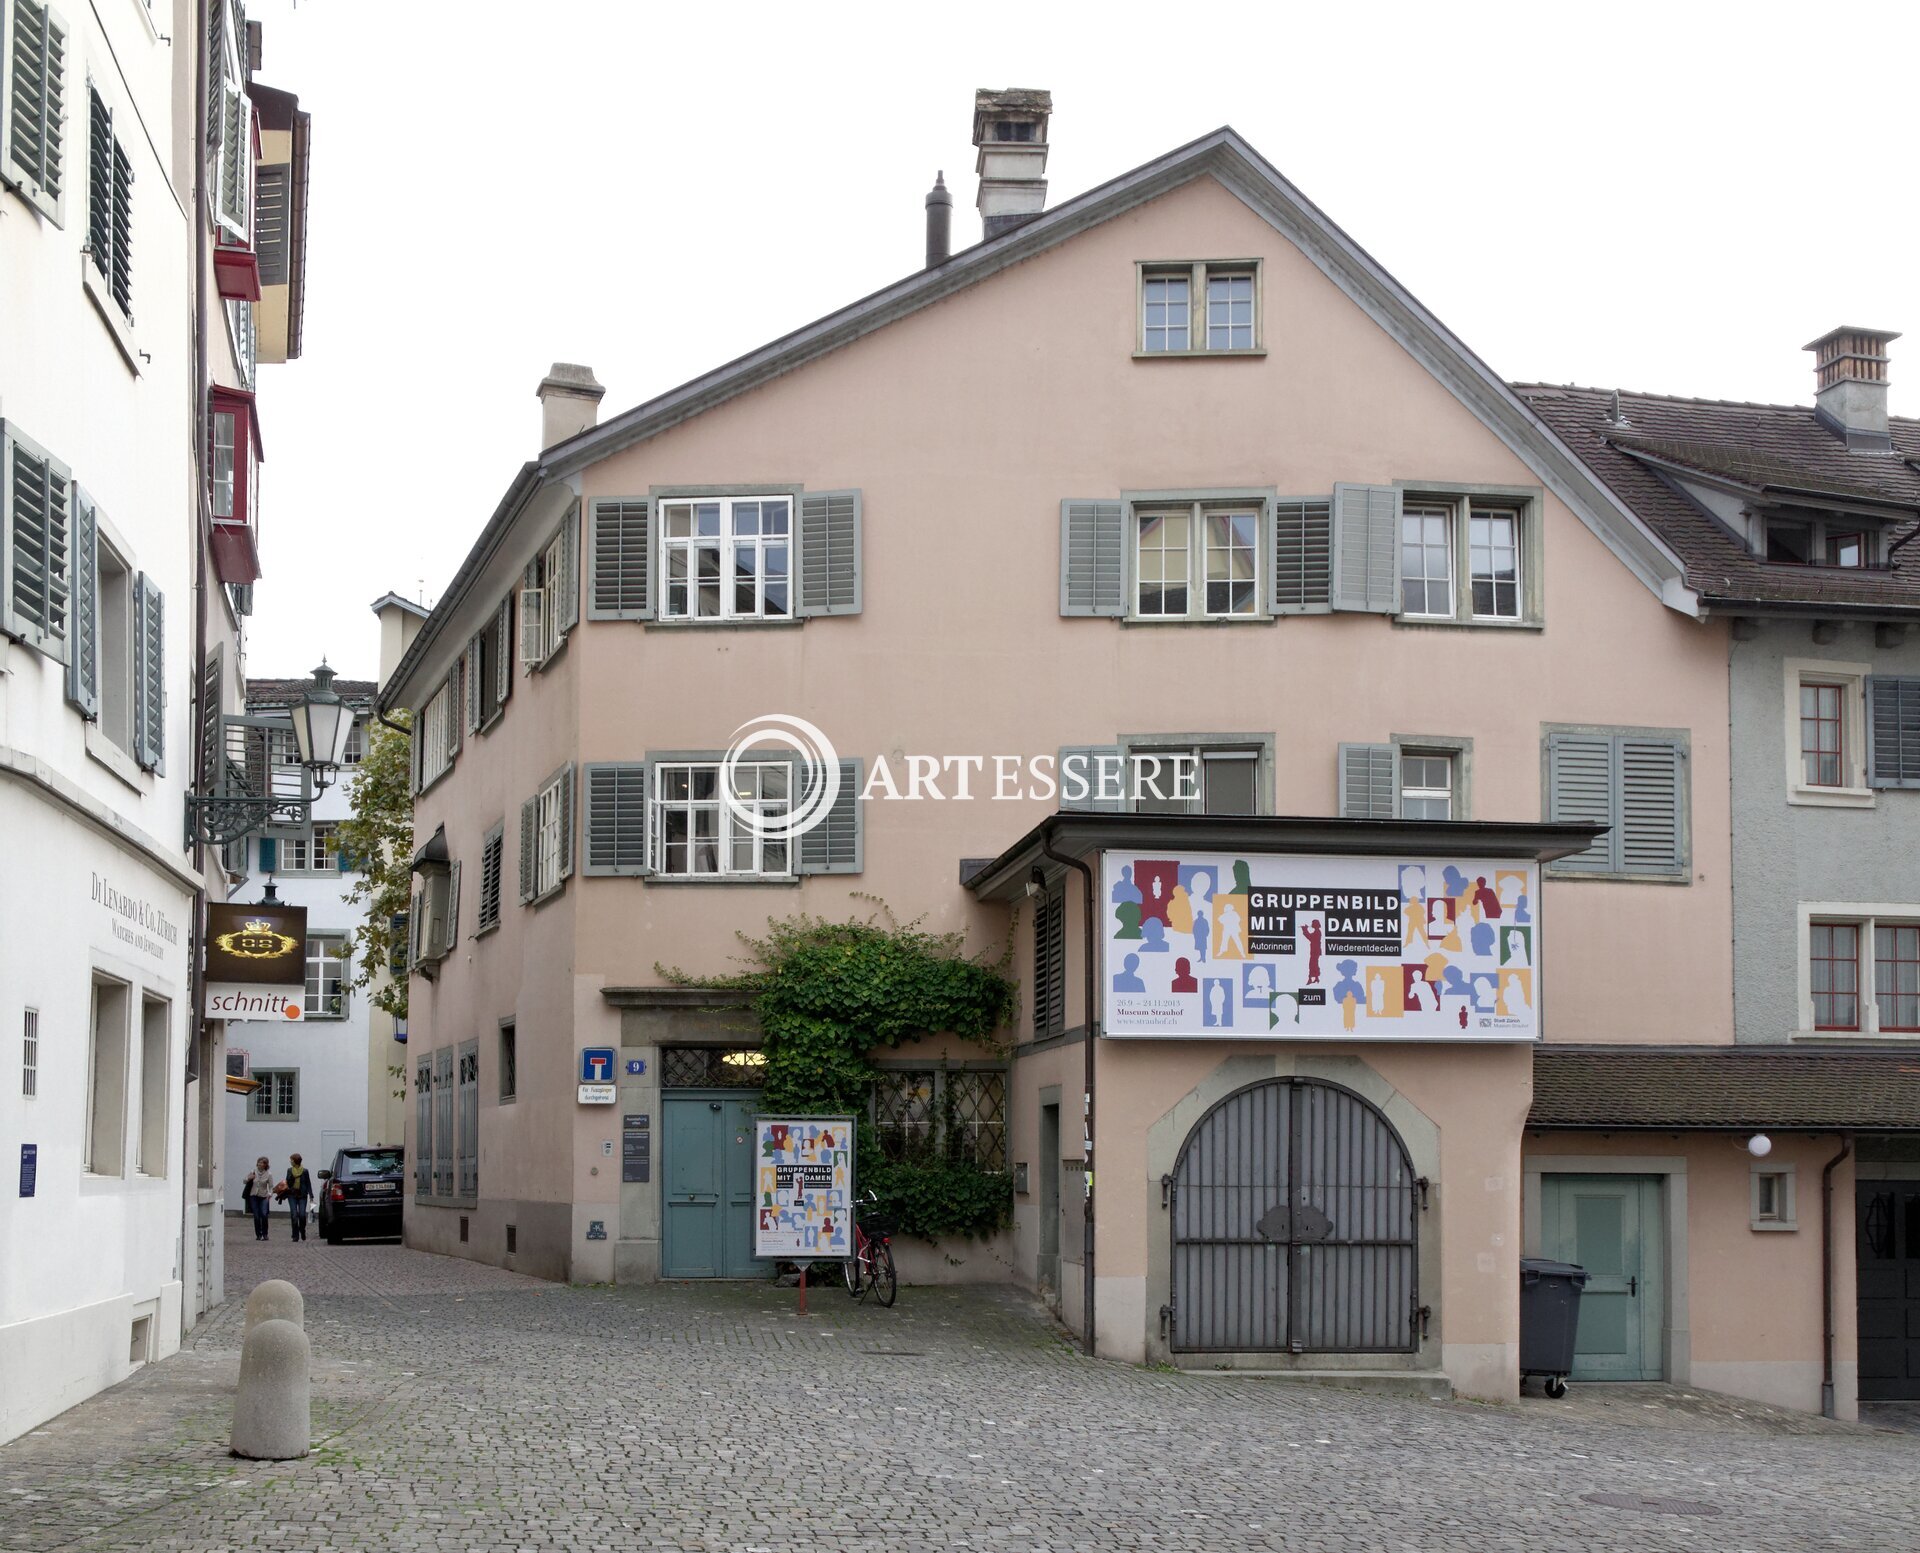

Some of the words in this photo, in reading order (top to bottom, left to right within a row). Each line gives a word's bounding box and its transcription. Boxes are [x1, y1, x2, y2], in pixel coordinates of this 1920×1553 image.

[1250, 893, 1399, 911] GRUPPENBILD
[103, 878, 138, 922] LENARDO
[138, 899, 144, 926] &
[157, 910, 178, 946] ZÜRICH
[1250, 916, 1288, 931] MIT
[1327, 917, 1399, 933] DAMEN
[1250, 941, 1293, 952] Autorinnen
[1327, 943, 1400, 954] Wiederentdecken
[211, 991, 289, 1013] schnitt
[1303, 994, 1321, 1002] zum
[1117, 1008, 1149, 1016] Museum
[1151, 1008, 1185, 1016] Strauhof
[1117, 1017, 1178, 1025] www.strauhof.ch
[632, 1061, 640, 1072] 9
